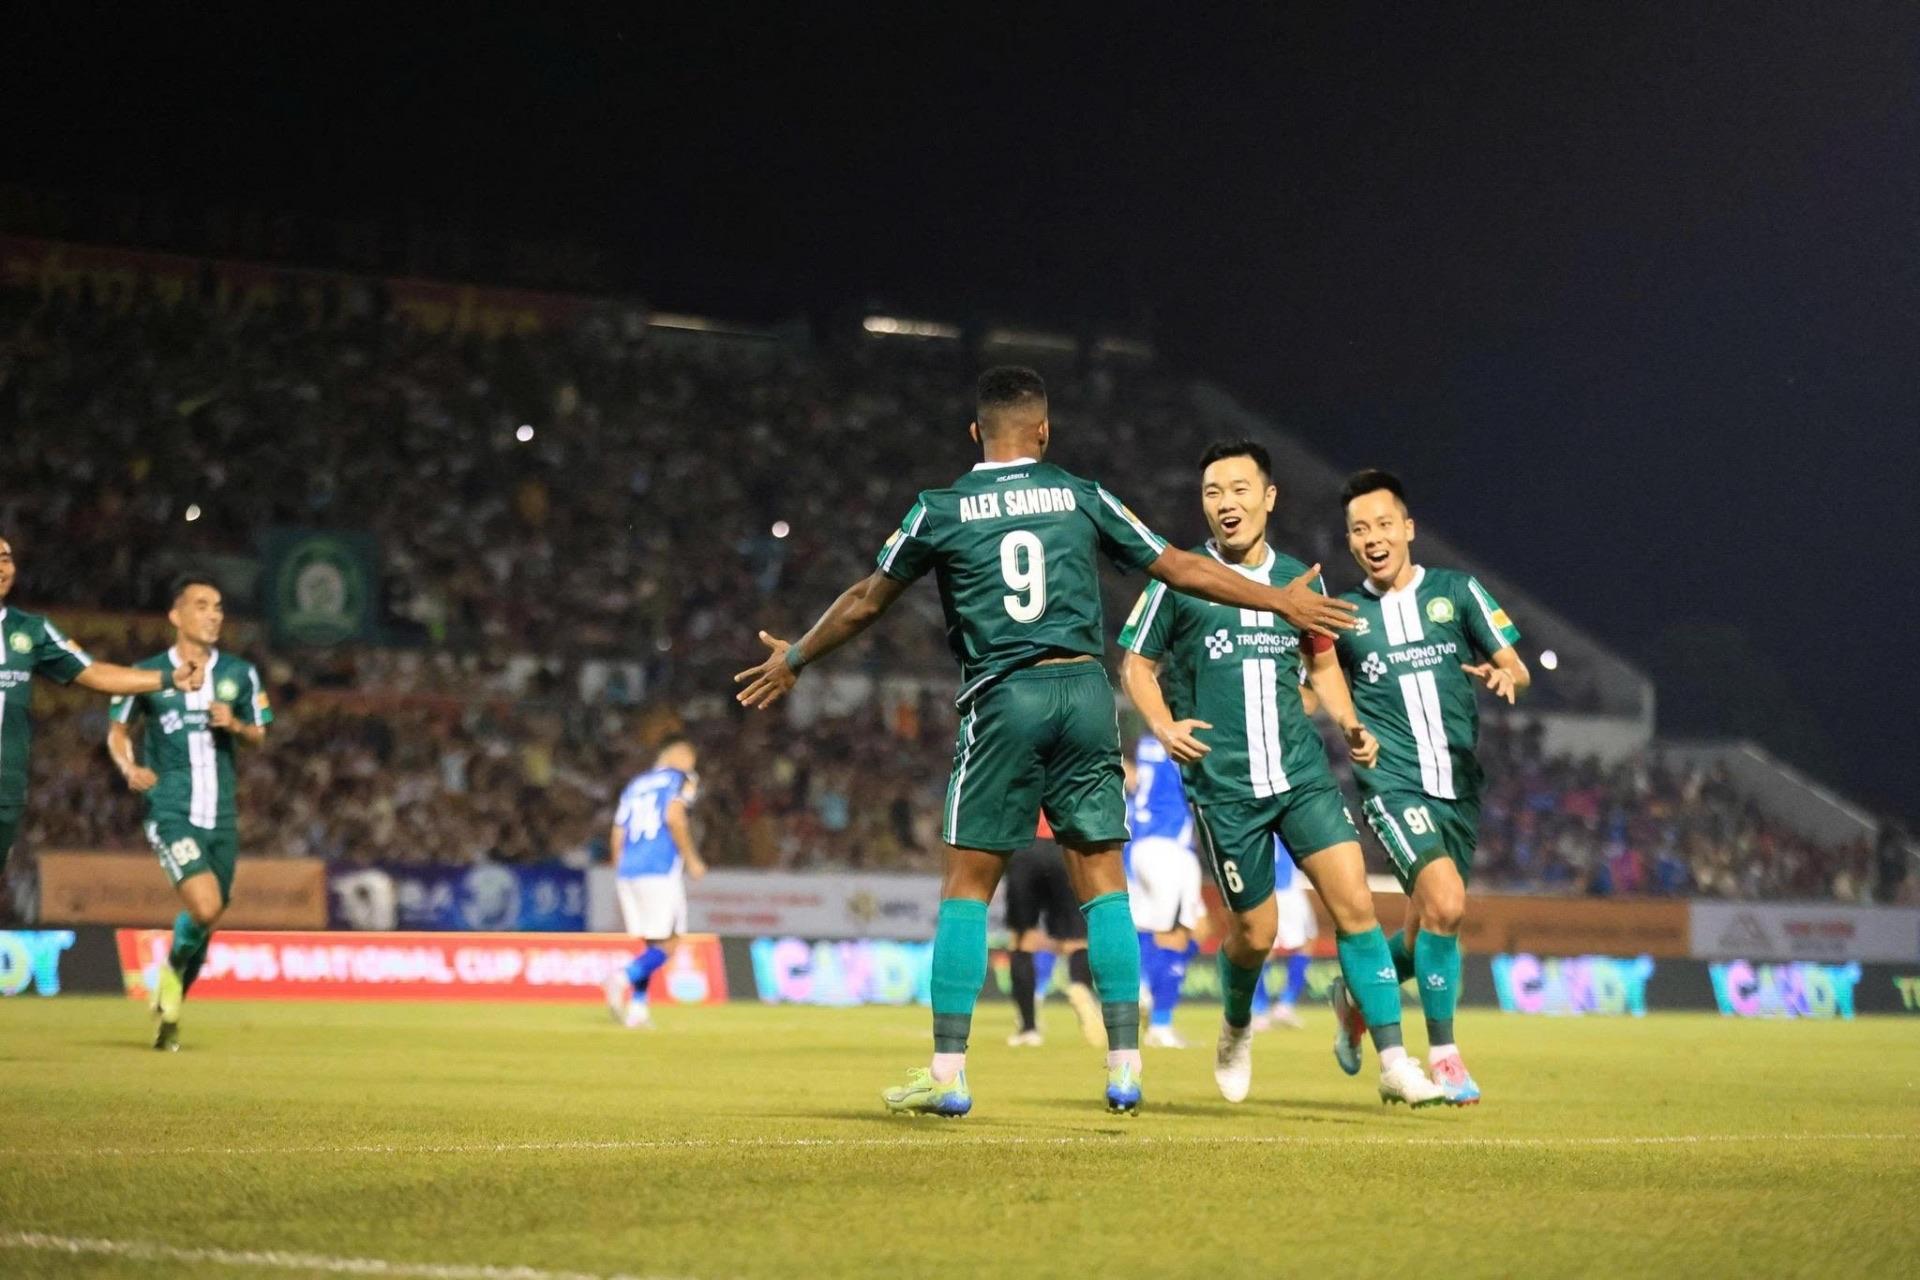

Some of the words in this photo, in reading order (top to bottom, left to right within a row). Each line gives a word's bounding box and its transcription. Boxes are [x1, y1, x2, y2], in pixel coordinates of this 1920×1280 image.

[959, 492, 1001, 523] ALEX
[1003, 487, 1076, 517] SANDRO
[1000, 530, 1047, 624] 9
[1257, 645, 1286, 654] GROUP
[1411, 656, 1444, 669] GROUP
[1403, 804, 1436, 835] 91
[1223, 860, 1244, 893] 6
[280, 945, 455, 984] NATIONAL
[454, 946, 524, 984] CUP
